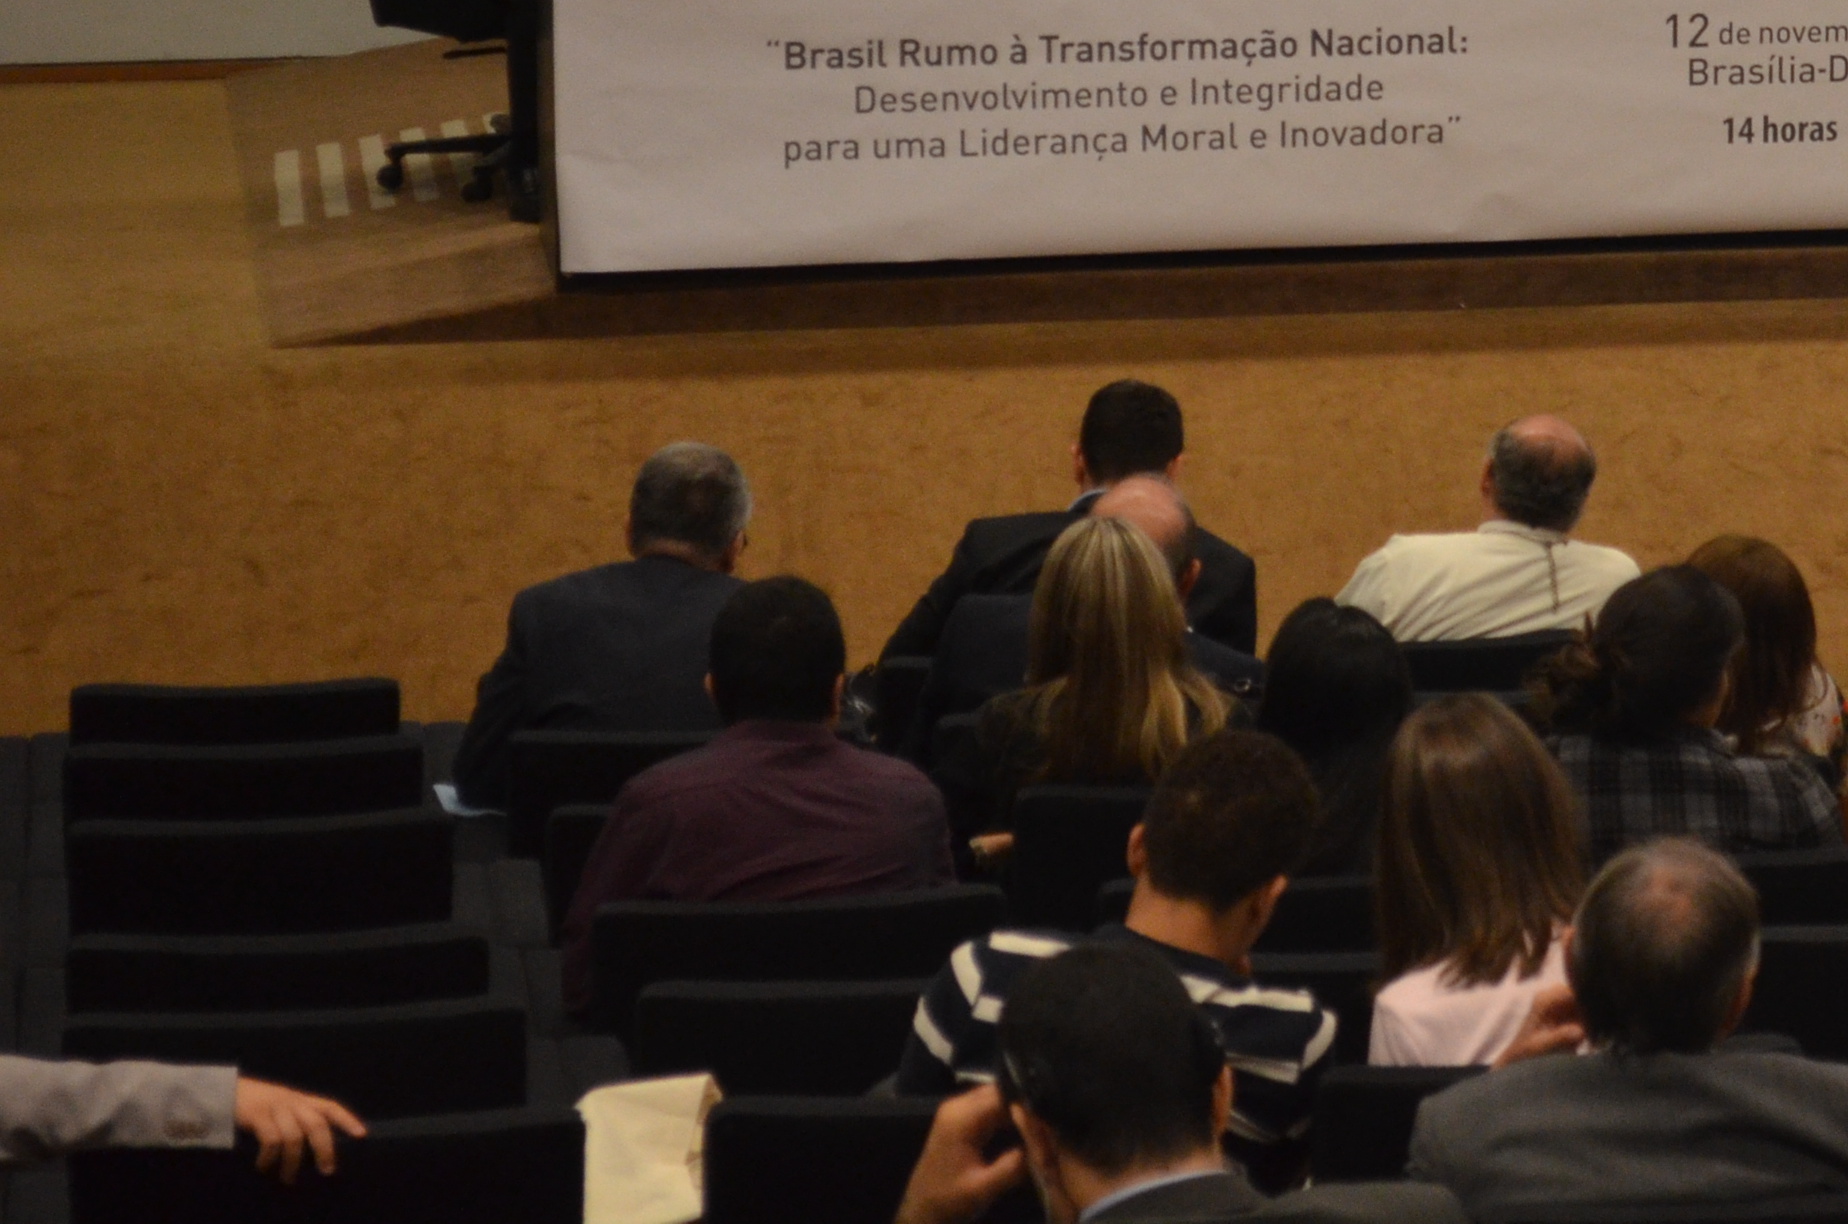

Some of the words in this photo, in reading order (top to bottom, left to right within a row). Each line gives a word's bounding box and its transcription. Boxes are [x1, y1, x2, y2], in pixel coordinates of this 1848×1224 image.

[899, 38, 998, 66] Rumo
[1010, 34, 1027, 64] à
[1039, 30, 1297, 66] Transformação
[1311, 26, 1467, 56] Nacional:
[1666, 13, 1708, 48] 12
[1719, 22, 1750, 45] de
[855, 82, 1147, 114] Desenvolvimento
[1160, 86, 1177, 106] e
[1191, 74, 1383, 111] Integridade
[784, 139, 859, 169] para
[873, 138, 945, 159] uma
[960, 128, 1127, 161] Liderança
[1142, 122, 1237, 151] Moral
[1250, 129, 1267, 149] e
[1724, 117, 1754, 143] 14
[1763, 115, 1837, 143] horas
